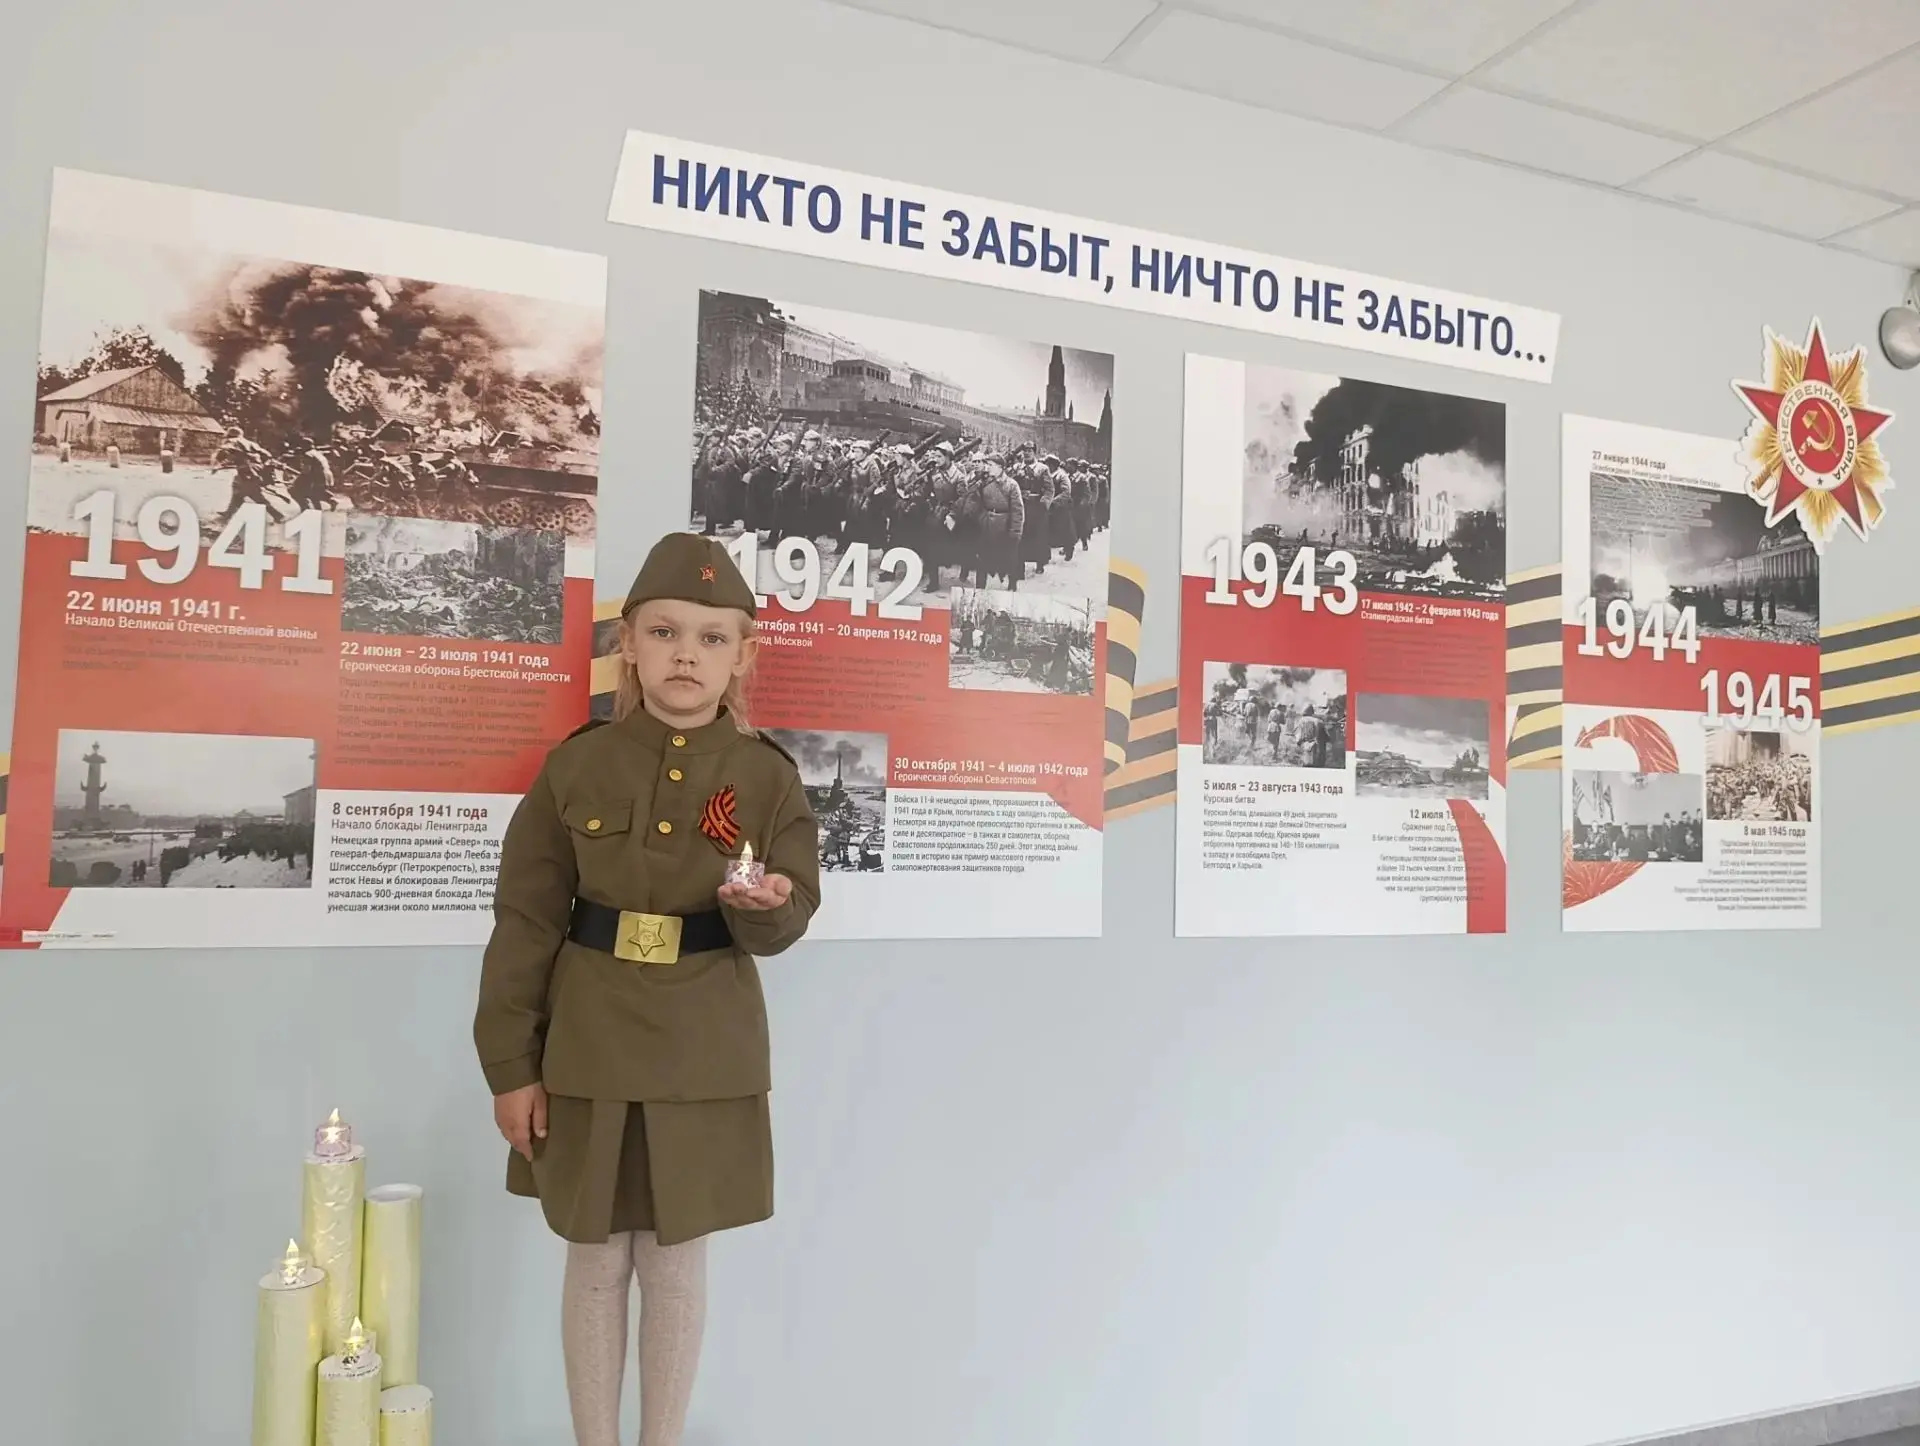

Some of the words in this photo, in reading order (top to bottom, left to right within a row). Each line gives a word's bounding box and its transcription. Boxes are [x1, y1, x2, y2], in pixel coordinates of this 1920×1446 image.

[652, 153, 842, 235] НИКТО
[860, 192, 926, 251] НЕ
[941, 208, 1114, 294] ЗАБЫТ,
[1131, 244, 1279, 312] НИЧТО
[1293, 276, 1345, 326] НЕ
[1356, 288, 1547, 364] ЗАБЫТО...
[1592, 450, 1601, 460] 27
[1603, 453, 1629, 465] января
[1631, 456, 1648, 466] 1944
[1649, 460, 1665, 470] года
[69, 490, 334, 595] 1941
[728, 531, 924, 622] 1942
[1204, 535, 1359, 616] 1943
[66, 590, 94, 610] 22
[101, 597, 161, 615] июня
[170, 597, 220, 618] 1941
[229, 605, 244, 620] г.
[1361, 599, 1371, 610] 17
[1372, 601, 1393, 611] июля
[1395, 601, 1413, 612] 1942
[1422, 603, 1427, 614] 2
[1428, 604, 1461, 618] февраля
[1463, 607, 1480, 618] 1943
[1482, 611, 1499, 621] года
[65, 612, 115, 627] Начало
[118, 615, 174, 630] Великой
[177, 619, 274, 637] Отечественной
[276, 625, 317, 639] войны
[752, 618, 795, 634] ентября
[799, 621, 823, 634] 1941
[837, 623, 850, 636] 20
[853, 628, 889, 641] апреля
[893, 628, 917, 641] 1942
[919, 632, 942, 645] года
[1578, 596, 1702, 664] 1944
[773, 636, 812, 647] Москвой
[340, 641, 359, 655] 22
[363, 645, 401, 657] июня
[419, 646, 436, 659] 23
[440, 650, 477, 662] июля
[482, 650, 513, 664] 1941
[518, 655, 549, 668] года
[340, 658, 411, 675] Героическая
[414, 663, 460, 678] оборона
[463, 665, 519, 681] Брестской
[521, 671, 570, 684] крепости
[1700, 669, 1813, 732] 1945
[894, 757, 908, 768] 30
[911, 758, 956, 773] октября
[960, 759, 984, 771] 1941
[998, 761, 1004, 772] 4
[1007, 763, 1035, 773] июля
[1038, 762, 1063, 774] 1942
[1065, 766, 1088, 777] года
[893, 771, 946, 783] Героическая
[948, 773, 983, 784] оборона
[984, 774, 1036, 784] Севастополя
[1203, 780, 1209, 789] 5
[1212, 782, 1236, 790] июля
[1248, 781, 1259, 791] 23
[1261, 783, 1296, 794] августа
[1299, 782, 1321, 793] 1943
[1323, 785, 1343, 795] года
[1203, 795, 1233, 804] Курская
[1234, 795, 1255, 803] битва
[332, 802, 340, 814] 8
[345, 802, 413, 819] сентября
[419, 804, 451, 817] 1941
[456, 808, 487, 820] года
[1410, 808, 1419, 818] 12
[1421, 811, 1443, 819] июля
[331, 819, 372, 829] Начало
[374, 819, 422, 831] блокады
[425, 820, 487, 833] Ленинграда
[1743, 825, 1748, 835] 8
[1750, 827, 1766, 836] мая
[1768, 826, 1787, 836] 1945
[1788, 828, 1805, 837] года
[331, 835, 378, 845] Немецкая
[380, 838, 412, 847] группа
[413, 836, 443, 847] армий
[445, 837, 480, 847] «Север»
[483, 839, 499, 847] под
[330, 849, 442, 860] генерал-фельдмаршала
[443, 851, 461, 860] фон
[464, 851, 491, 859] Лееба
[329, 862, 397, 873] Шлиссельбург
[399, 863, 477, 873] (Петрокрепость),
[358, 875, 383, 884] Невы
[394, 876, 448, 886] блокировав
[327, 890, 372, 898] началась
[374, 889, 432, 899] 900-дневная
[434, 889, 472, 899] блокада
[327, 904, 367, 913] унесшая
